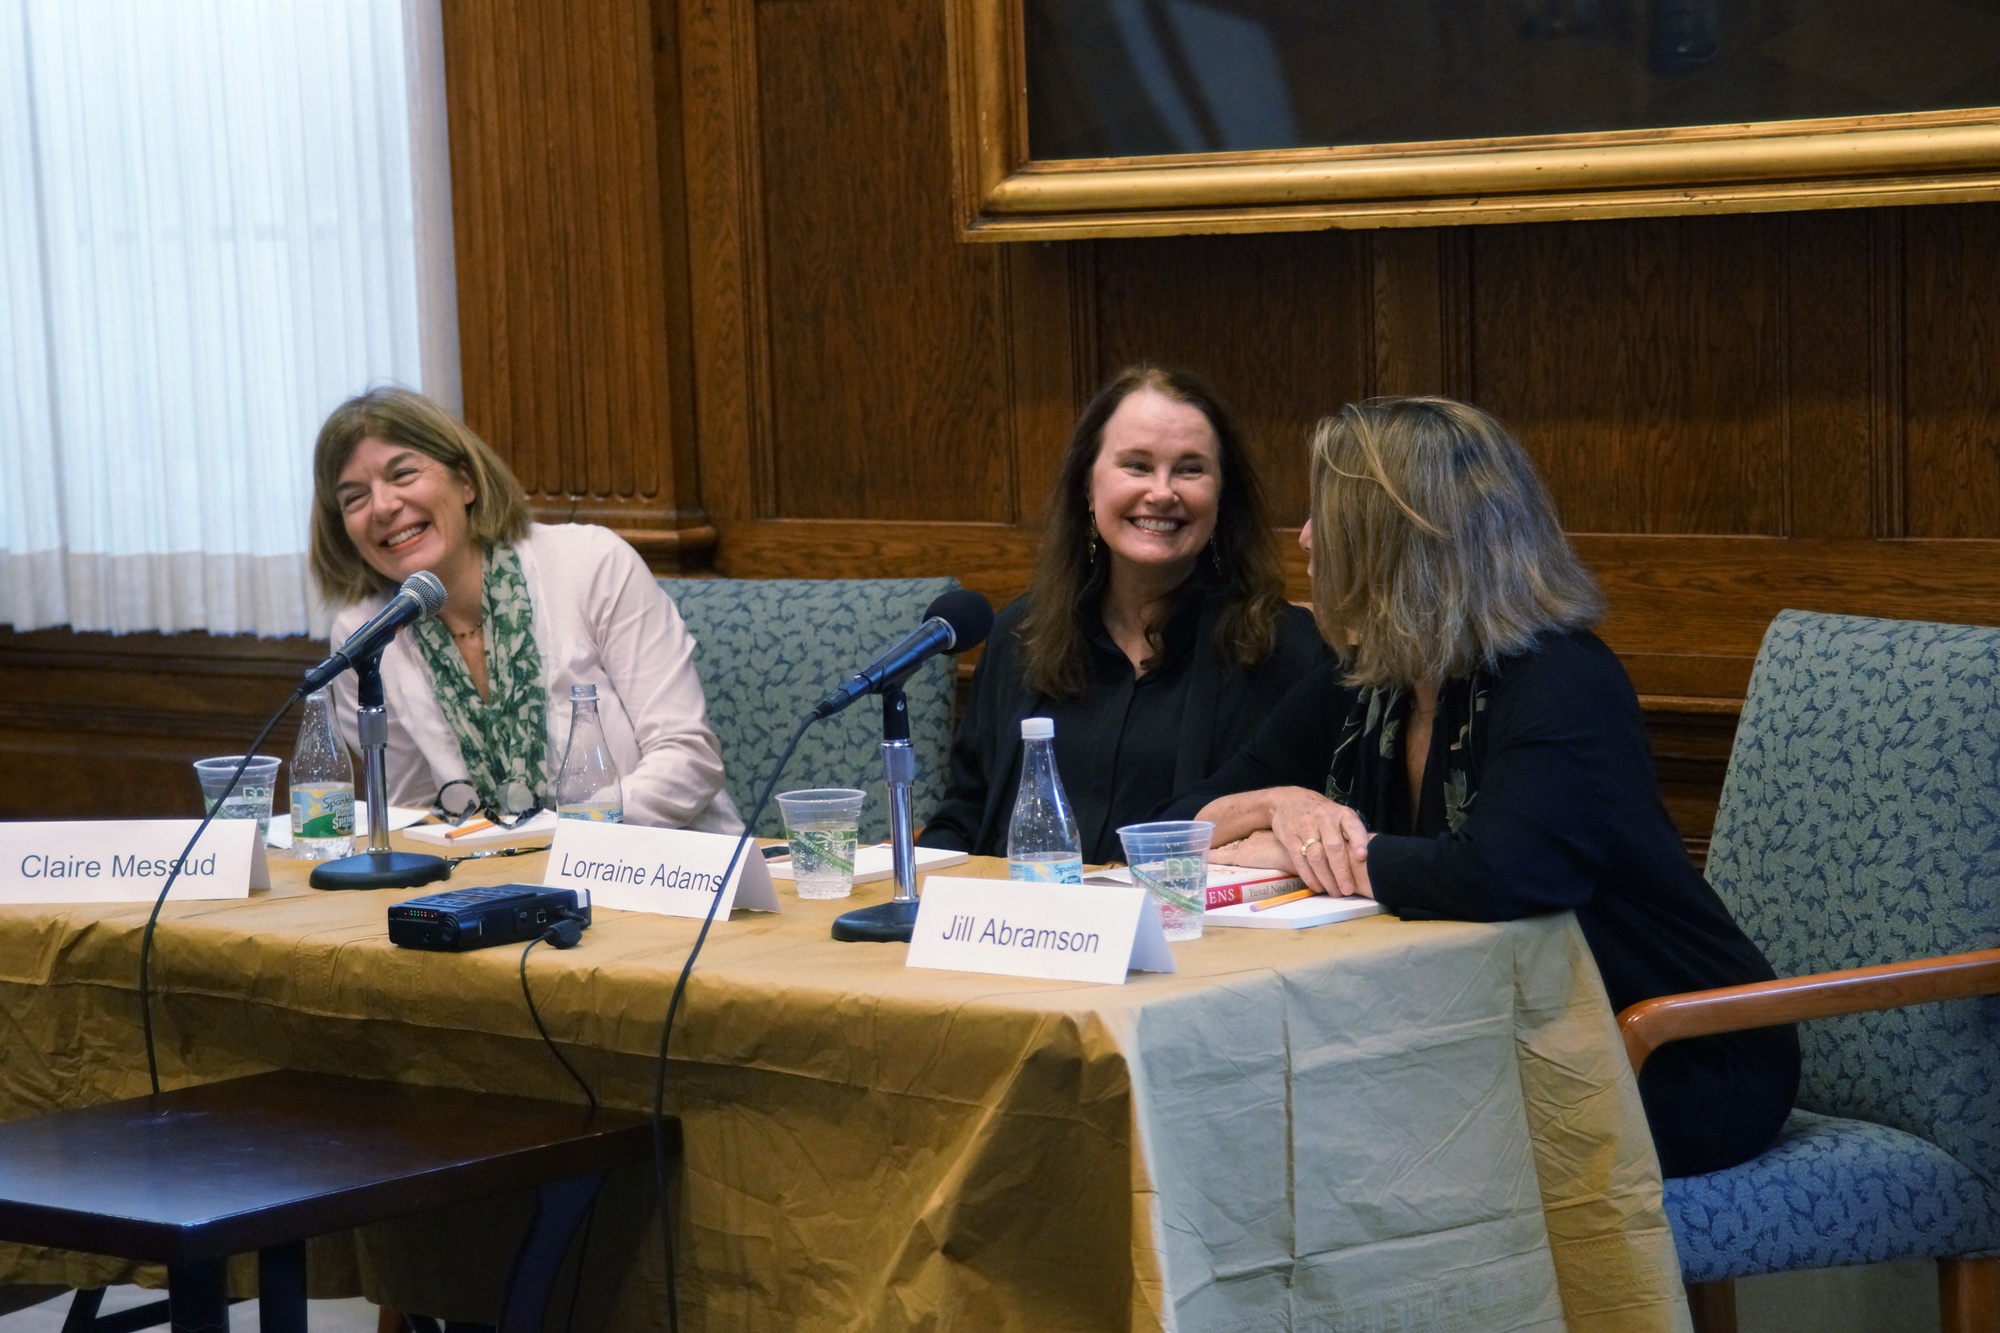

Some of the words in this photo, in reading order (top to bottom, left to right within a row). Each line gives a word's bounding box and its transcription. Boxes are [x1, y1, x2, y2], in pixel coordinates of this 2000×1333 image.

[21, 854, 101, 878] Claire
[561, 853, 646, 885] Lorraine
[650, 863, 724, 893] Adams
[1205, 888, 1235, 904] ENS
[1249, 886, 1269, 897] Yuval
[1271, 882, 1292, 894] Noah
[942, 915, 976, 942] Jill
[979, 918, 1099, 953] Abramson
